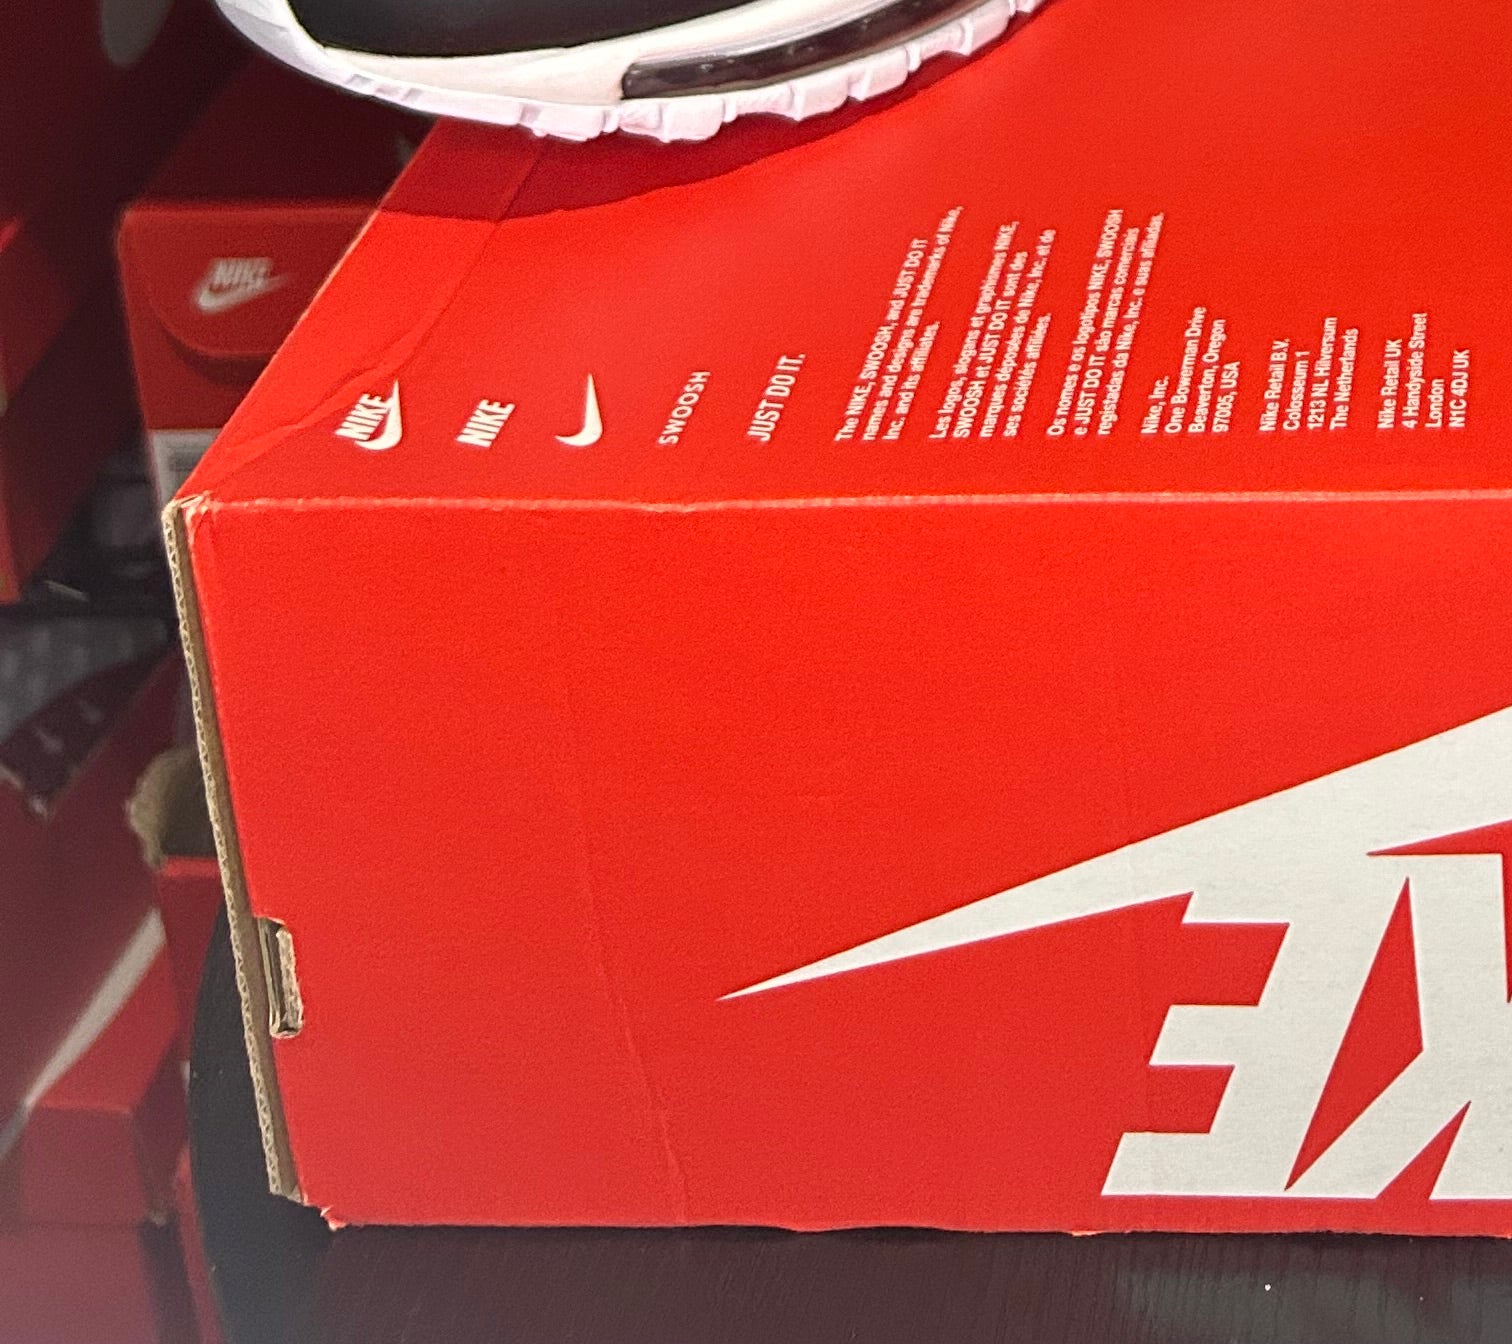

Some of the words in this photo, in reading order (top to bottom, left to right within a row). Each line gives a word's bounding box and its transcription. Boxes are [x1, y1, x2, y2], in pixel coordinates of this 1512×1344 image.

[938, 206, 962, 232] Nike,
[910, 238, 927, 248] IT
[935, 233, 950, 245] of
[1036, 244, 1050, 255] et
[1039, 229, 1055, 243] de
[213, 257, 274, 289] NIKE
[903, 251, 923, 267] DO
[1009, 251, 1027, 271] des
[1026, 257, 1047, 277] Inc.
[892, 270, 914, 297] JUST
[911, 247, 945, 306] trademarks
[1002, 272, 1020, 297] sont
[994, 299, 1011, 310] IT
[1017, 279, 1041, 307] Nike,
[886, 299, 904, 320] and
[905, 309, 922, 326] are
[987, 311, 1007, 330] DO
[1013, 309, 1030, 323] de
[1184, 307, 1206, 337] Drive
[1202, 319, 1226, 362] Oregon
[1408, 313, 1426, 348] Street
[859, 322, 897, 379] SWOOSH,
[886, 328, 914, 372] designs
[910, 321, 938, 372] affiliates.
[978, 333, 999, 363] JUST
[995, 326, 1025, 381] déposées
[1270, 338, 1288, 361] B.V.
[1314, 317, 1336, 376] Hilversum
[1384, 339, 1401, 357] UK
[1452, 349, 1469, 368] UK
[776, 354, 804, 371] IT.
[975, 365, 991, 378] et
[1170, 339, 1198, 404] Bowerman
[1220, 361, 1239, 388] USA
[1334, 328, 1357, 401] Netherlands
[765, 374, 794, 396] DO
[878, 375, 897, 397] and
[900, 374, 920, 389] its
[1148, 375, 1168, 398] Inc.
[1264, 363, 1284, 399] Retail
[1310, 379, 1329, 397] NL
[1380, 360, 1399, 396] Retail
[1402, 351, 1424, 416] Handyside
[1450, 371, 1468, 396] 4DJ
[658, 371, 709, 444] SWOOSH
[845, 382, 875, 414] NIKE,
[895, 391, 913, 414] and
[953, 381, 984, 437] SWOOSH
[1187, 365, 1218, 432] Beaverton,
[1283, 360, 1307, 430] Colosseum
[1425, 378, 1444, 427] London
[334, 393, 391, 439] NIKE
[457, 400, 513, 446] NIKE
[747, 399, 782, 441] JUST
[863, 399, 888, 440] names
[979, 384, 1007, 437] marques
[1140, 401, 1165, 434] Nike,
[1164, 406, 1185, 433] One
[1211, 391, 1236, 432] 97005,
[1259, 401, 1279, 431] Nike
[1307, 399, 1325, 429] 1213
[1329, 404, 1348, 429] The
[1377, 398, 1396, 428] Nike
[1401, 419, 1417, 428] 4
[1448, 399, 1466, 427] N1C
[834, 417, 858, 440] The
[882, 417, 905, 440] Inc.
